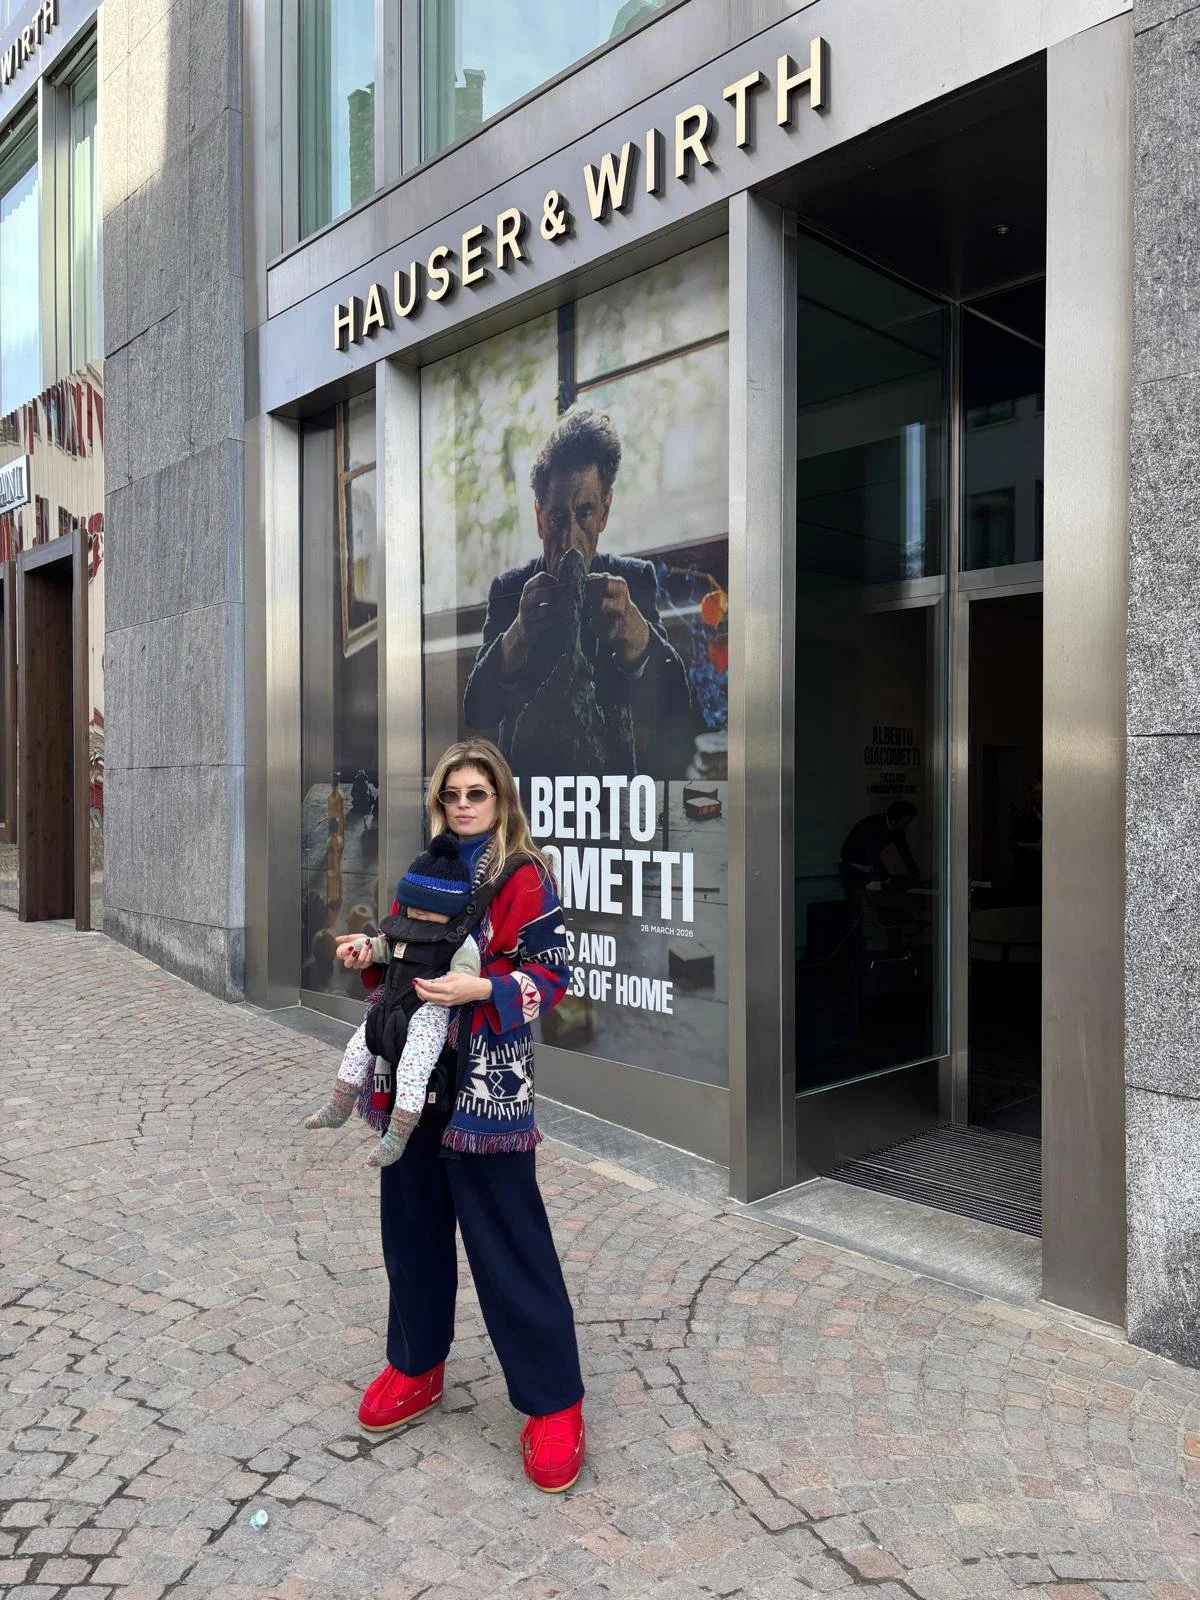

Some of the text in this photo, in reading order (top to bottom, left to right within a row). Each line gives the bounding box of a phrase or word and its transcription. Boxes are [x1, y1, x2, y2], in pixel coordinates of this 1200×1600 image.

[0, 0, 58, 85] WIRTH
[333, 36, 829, 351] HAUSER & WIRTH
[578, 932, 617, 967] AND
[640, 924, 694, 938] 28 MARCH 2026
[589, 969, 612, 1002] OF
[615, 973, 674, 1015] HOME
